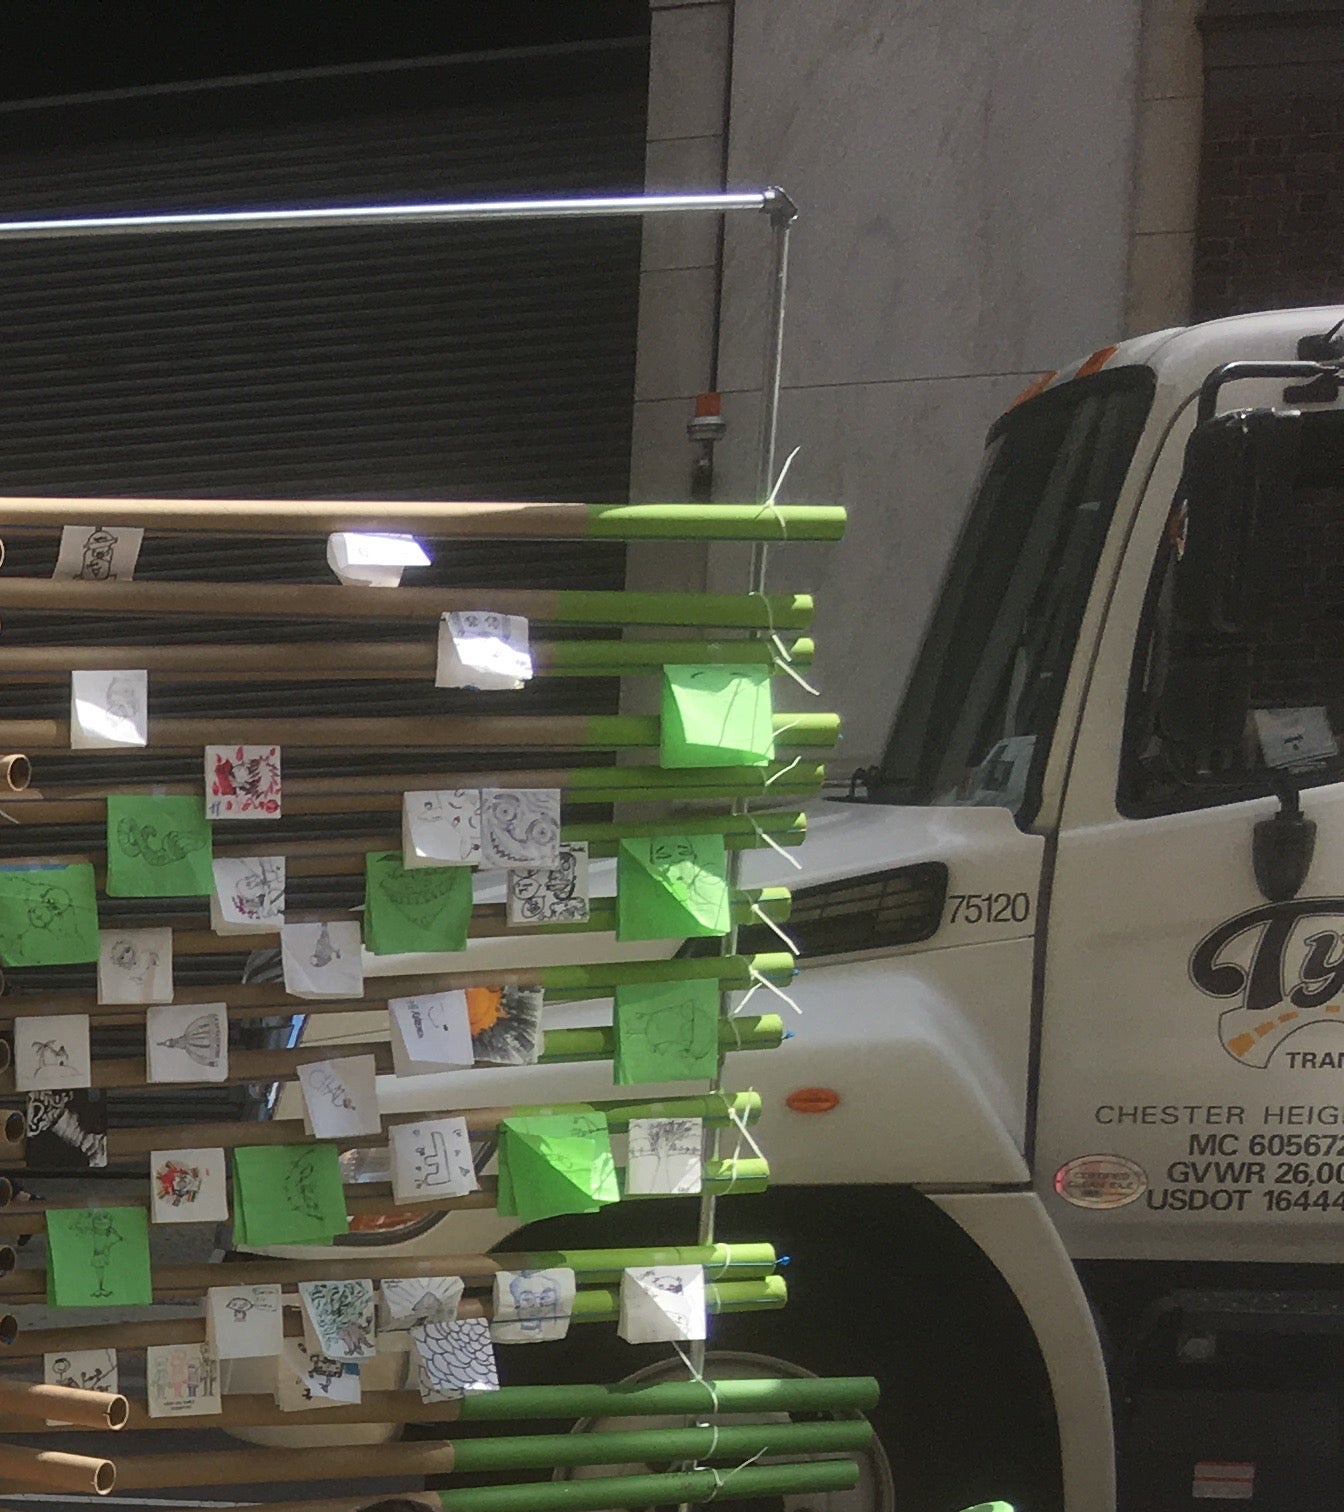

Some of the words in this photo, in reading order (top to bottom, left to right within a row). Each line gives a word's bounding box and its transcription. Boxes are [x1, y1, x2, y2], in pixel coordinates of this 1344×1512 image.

[948, 892, 1030, 924] 75120
[1094, 1105, 1246, 1126] CHESTER
[1264, 1105, 1344, 1126] HEIG
[1188, 1133, 1239, 1156] MC
[1167, 1161, 1265, 1184] GVWR
[1146, 1189, 1252, 1211] USDOT
